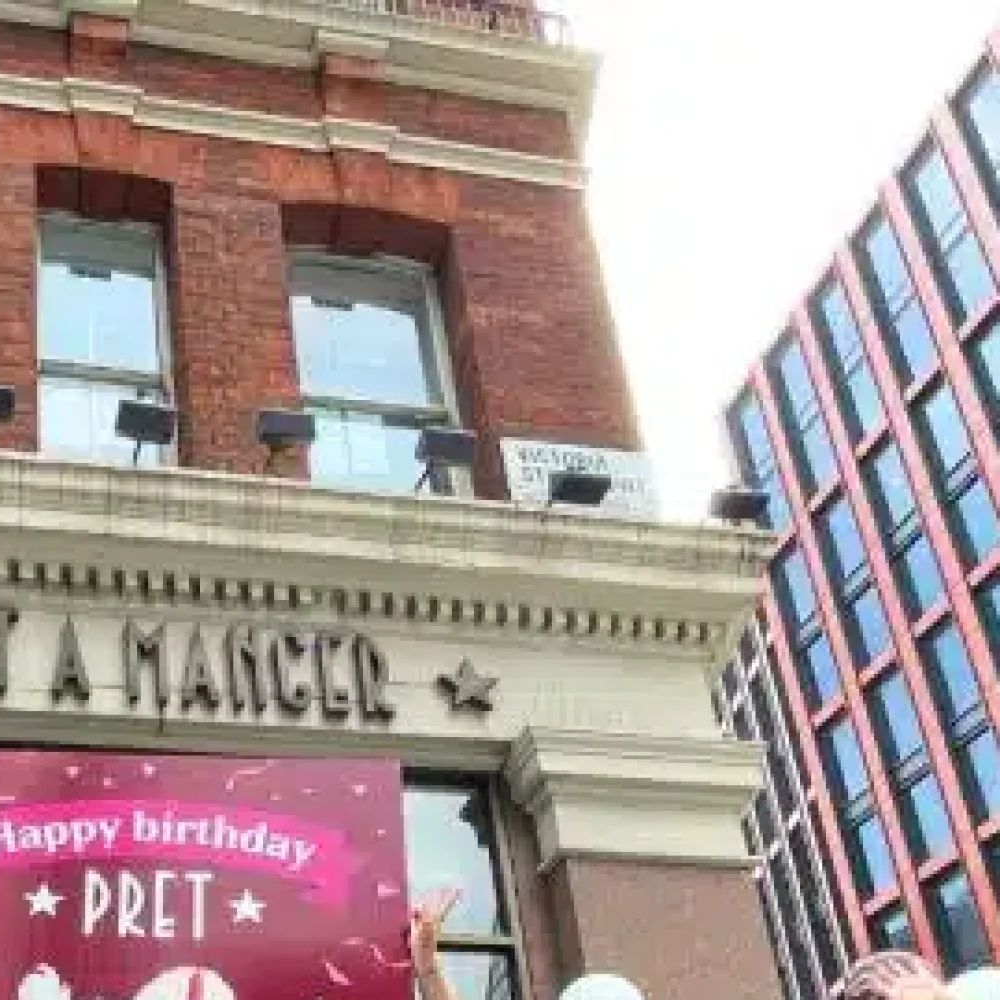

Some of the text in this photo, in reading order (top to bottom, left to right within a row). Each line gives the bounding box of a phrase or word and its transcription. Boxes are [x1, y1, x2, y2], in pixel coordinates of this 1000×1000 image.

[51, 611, 90, 703] A
[133, 811, 316, 871] birthday
[81, 869, 215, 938] PRET
